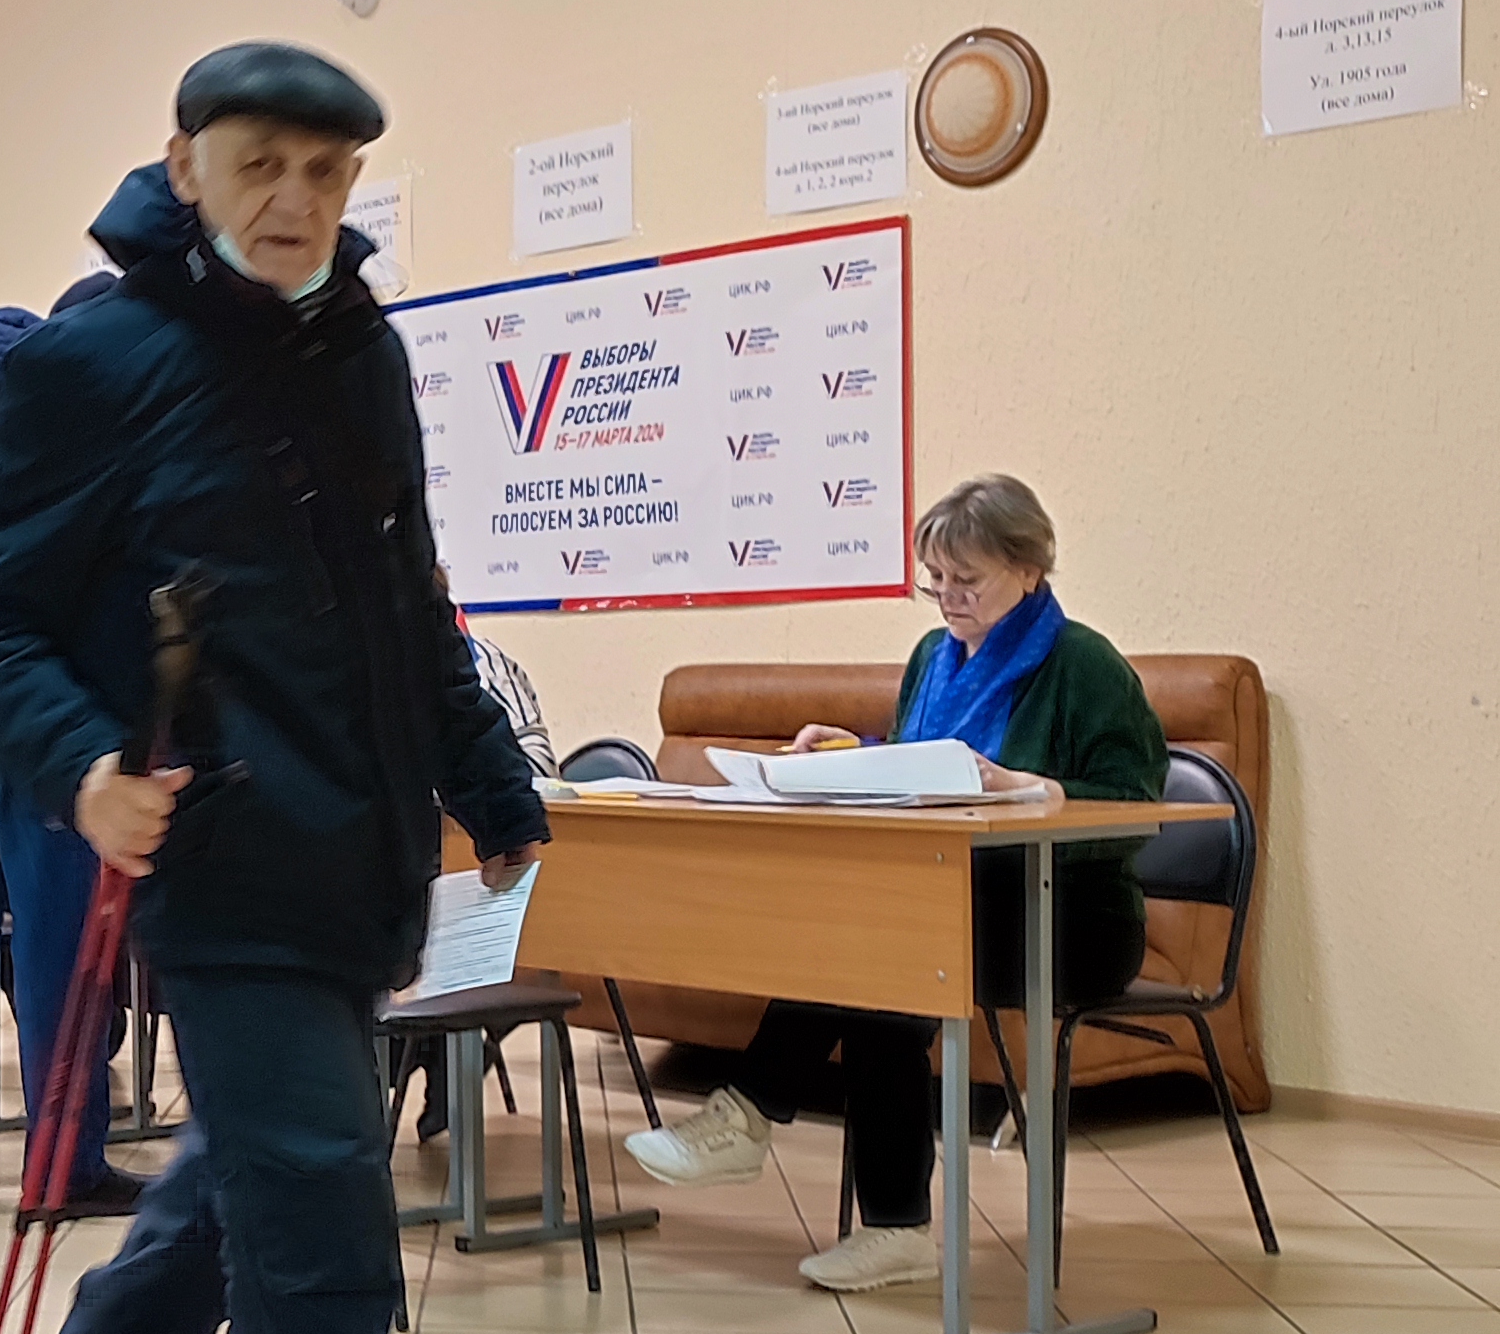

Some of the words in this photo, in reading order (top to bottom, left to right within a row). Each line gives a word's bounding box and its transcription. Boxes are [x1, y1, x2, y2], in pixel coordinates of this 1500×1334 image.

[1274, 24, 1308, 40] 4-ый
[1313, 9, 1375, 35] Норский
[1343, 27, 1393, 50] 3,13,15
[1310, 74, 1333, 91] Ул.
[1338, 66, 1372, 86] 1905
[1375, 62, 1408, 79] года
[847, 89, 893, 107] переулок
[1320, 96, 1350, 114] (все
[1353, 86, 1396, 108] дома)
[831, 113, 861, 129] дома)
[528, 155, 555, 175] 2-ой
[559, 142, 614, 168] Норский
[847, 149, 894, 167] переулок
[542, 174, 600, 198] переулок
[539, 207, 564, 225] (все
[566, 196, 603, 218] дома)
[729, 280, 771, 298] ЦИК.РФ
[826, 319, 869, 339] ЦИК.РФ
[580, 339, 657, 370] ВЫБОРЫ
[570, 364, 680, 398] ПРЕЗИДЕНТА
[730, 385, 773, 403] ЦИК.РФ
[561, 398, 632, 427] РОССИИ
[592, 426, 632, 448] МАРТА
[633, 422, 664, 444] 2024
[826, 430, 870, 448] ЦИК.РФ
[505, 479, 564, 504] ВМЕСТЕ
[570, 476, 600, 499] МЫ
[604, 471, 648, 496] СИЛА
[731, 492, 774, 509] ЦИК.РФ
[492, 508, 573, 535] ГОЛОСУЕМ
[577, 506, 600, 528] ЗА
[603, 499, 679, 527] РОССИЮ!
[827, 539, 870, 556] ЦИК.РФ
